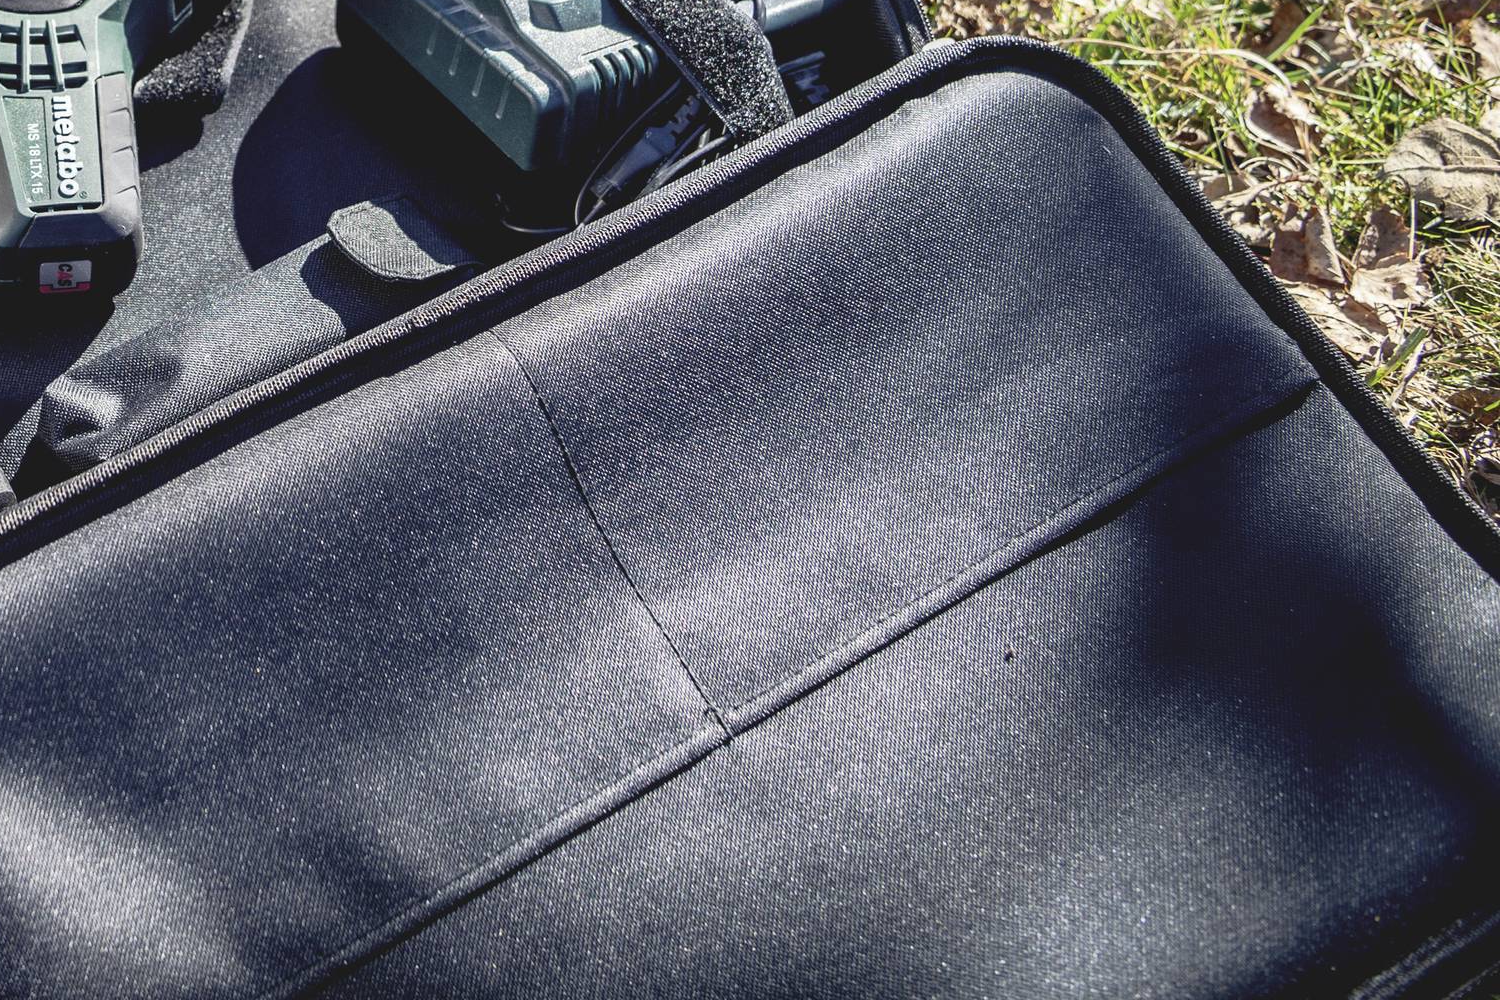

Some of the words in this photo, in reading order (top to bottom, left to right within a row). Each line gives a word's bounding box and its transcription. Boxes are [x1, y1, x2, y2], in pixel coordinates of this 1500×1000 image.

[27, 123, 40, 141] MS
[28, 143, 41, 157] 18
[51, 95, 84, 197] metabo
[30, 158, 44, 179] LTX
[31, 182, 44, 195] 15
[57, 264, 73, 286] CAS
